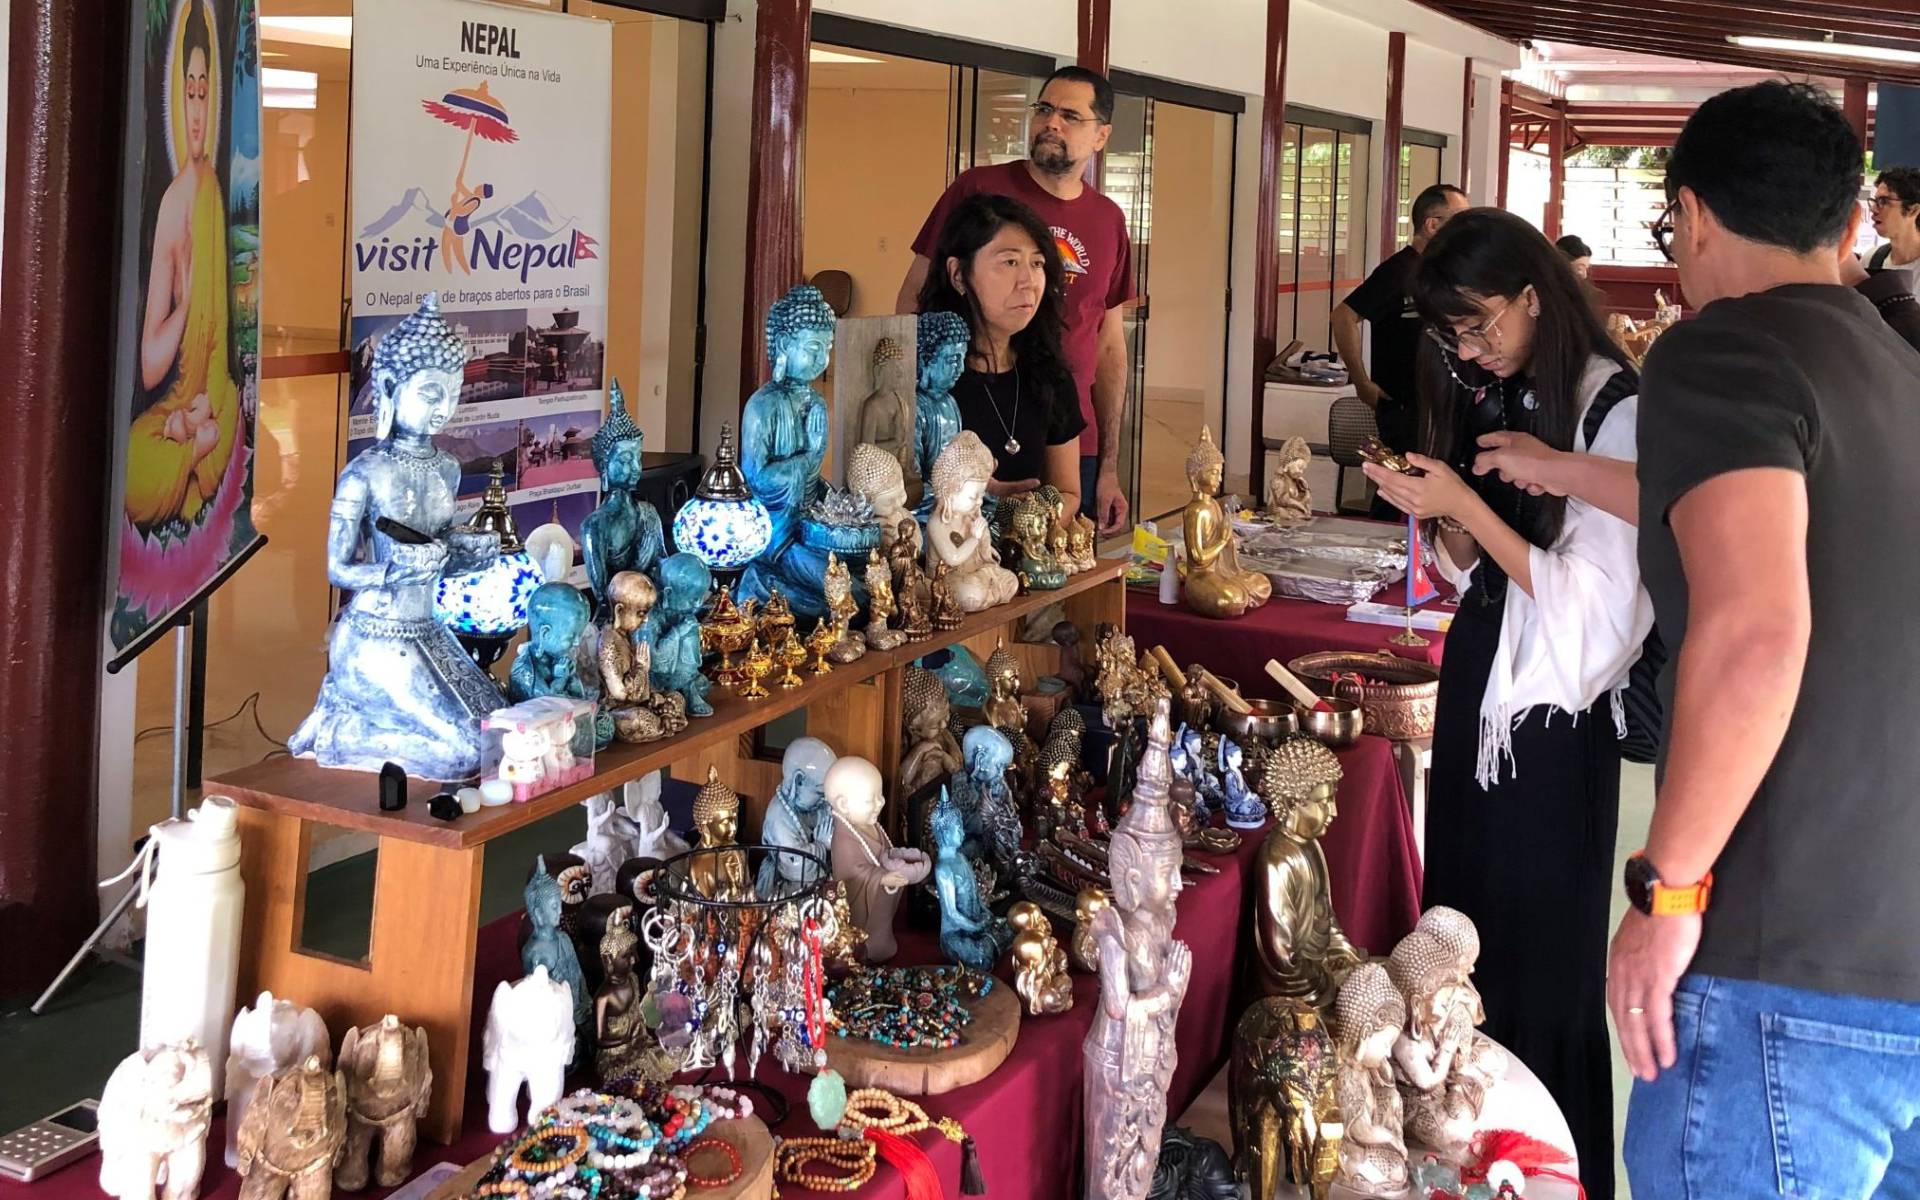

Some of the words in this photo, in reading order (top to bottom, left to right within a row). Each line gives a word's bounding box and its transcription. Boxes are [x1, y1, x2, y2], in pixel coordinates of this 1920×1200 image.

[461, 20, 521, 59] NEPAL
[415, 54, 440, 70] Uma
[442, 57, 498, 76] Experiência
[500, 62, 526, 79] Única
[528, 69, 540, 80] na
[542, 69, 561, 83] Vida
[355, 236, 439, 272] visit
[470, 228, 576, 284] Nepal
[1048, 226, 1068, 239] THE
[1066, 231, 1090, 267] WORLD
[366, 291, 377, 307] O
[379, 291, 413, 308] Nepal
[442, 289, 456, 303] de
[459, 289, 492, 305] braços
[495, 288, 531, 302] abertos
[533, 288, 553, 303] para
[555, 288, 561, 299] o
[563, 284, 590, 298] Brasil
